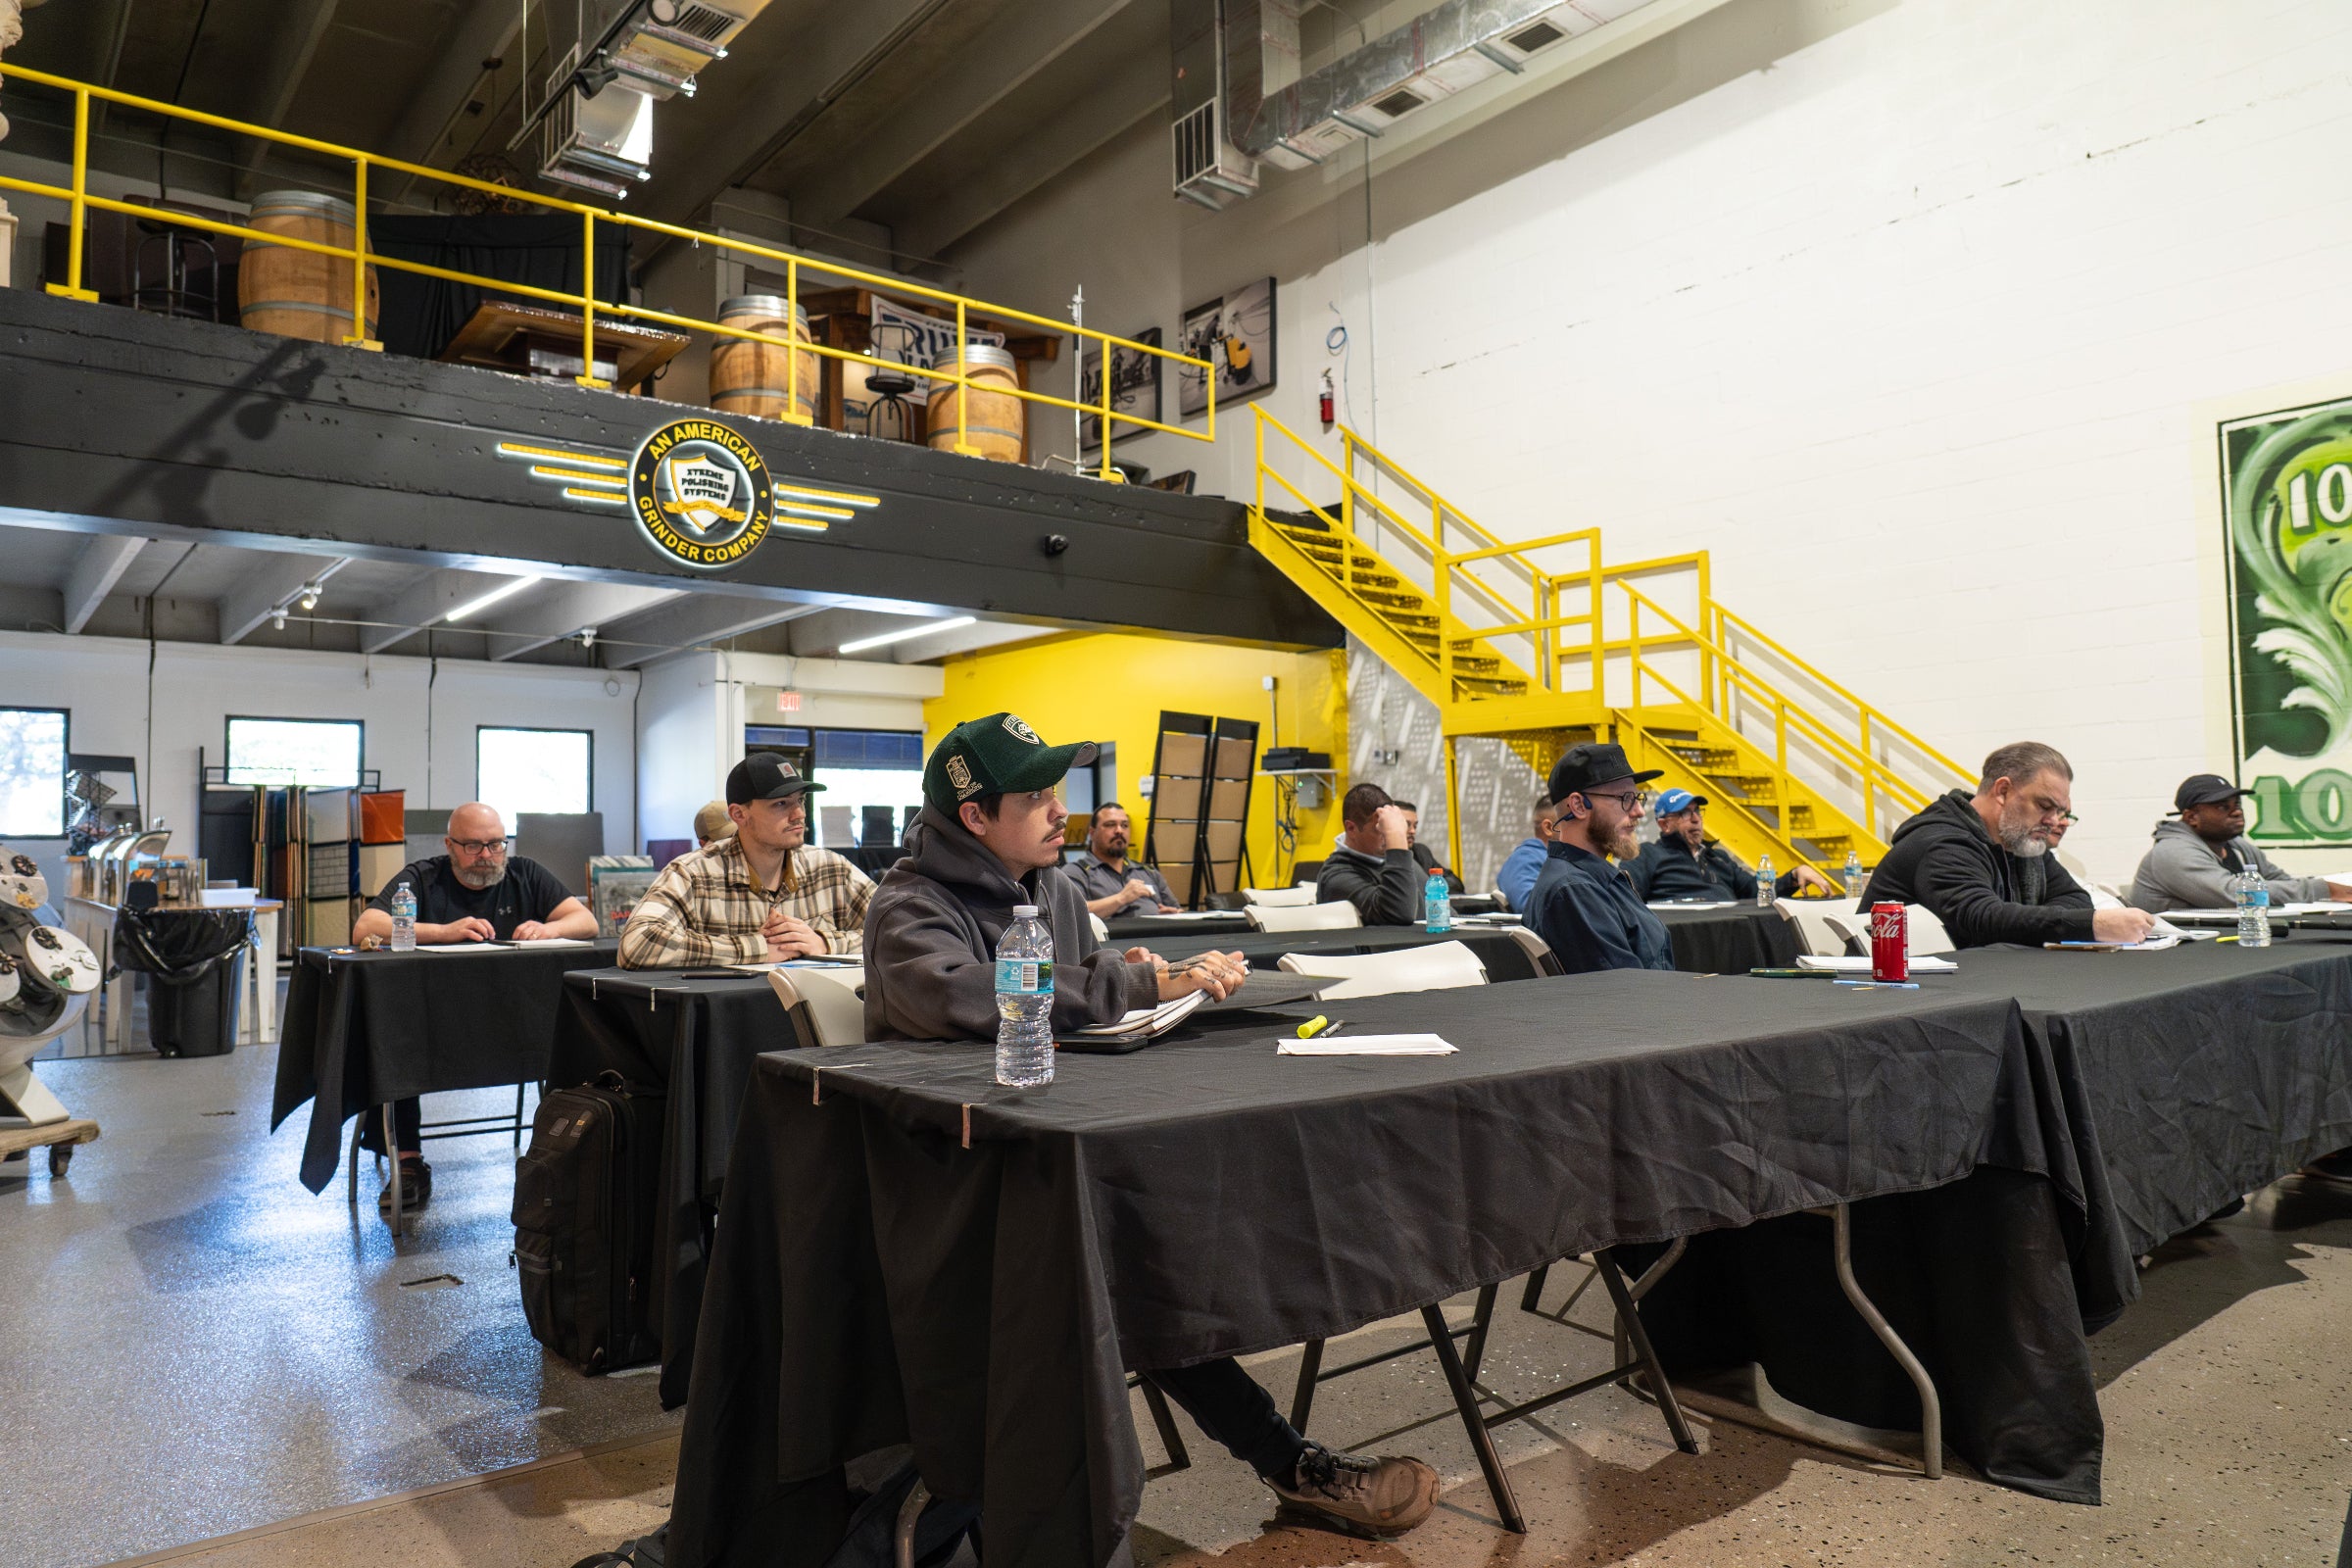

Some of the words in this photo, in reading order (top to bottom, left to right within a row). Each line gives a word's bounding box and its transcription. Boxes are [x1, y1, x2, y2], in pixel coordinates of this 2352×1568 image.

[648, 432, 673, 461] AN
[673, 422, 761, 472] AMERICAN
[687, 468, 724, 480] XTREME
[681, 477, 729, 492] POLISHING
[684, 488, 726, 501] SYSTEMS
[639, 496, 700, 561] GRINDER
[703, 510, 769, 563] COMPANY
[781, 695, 801, 711] EXIT
